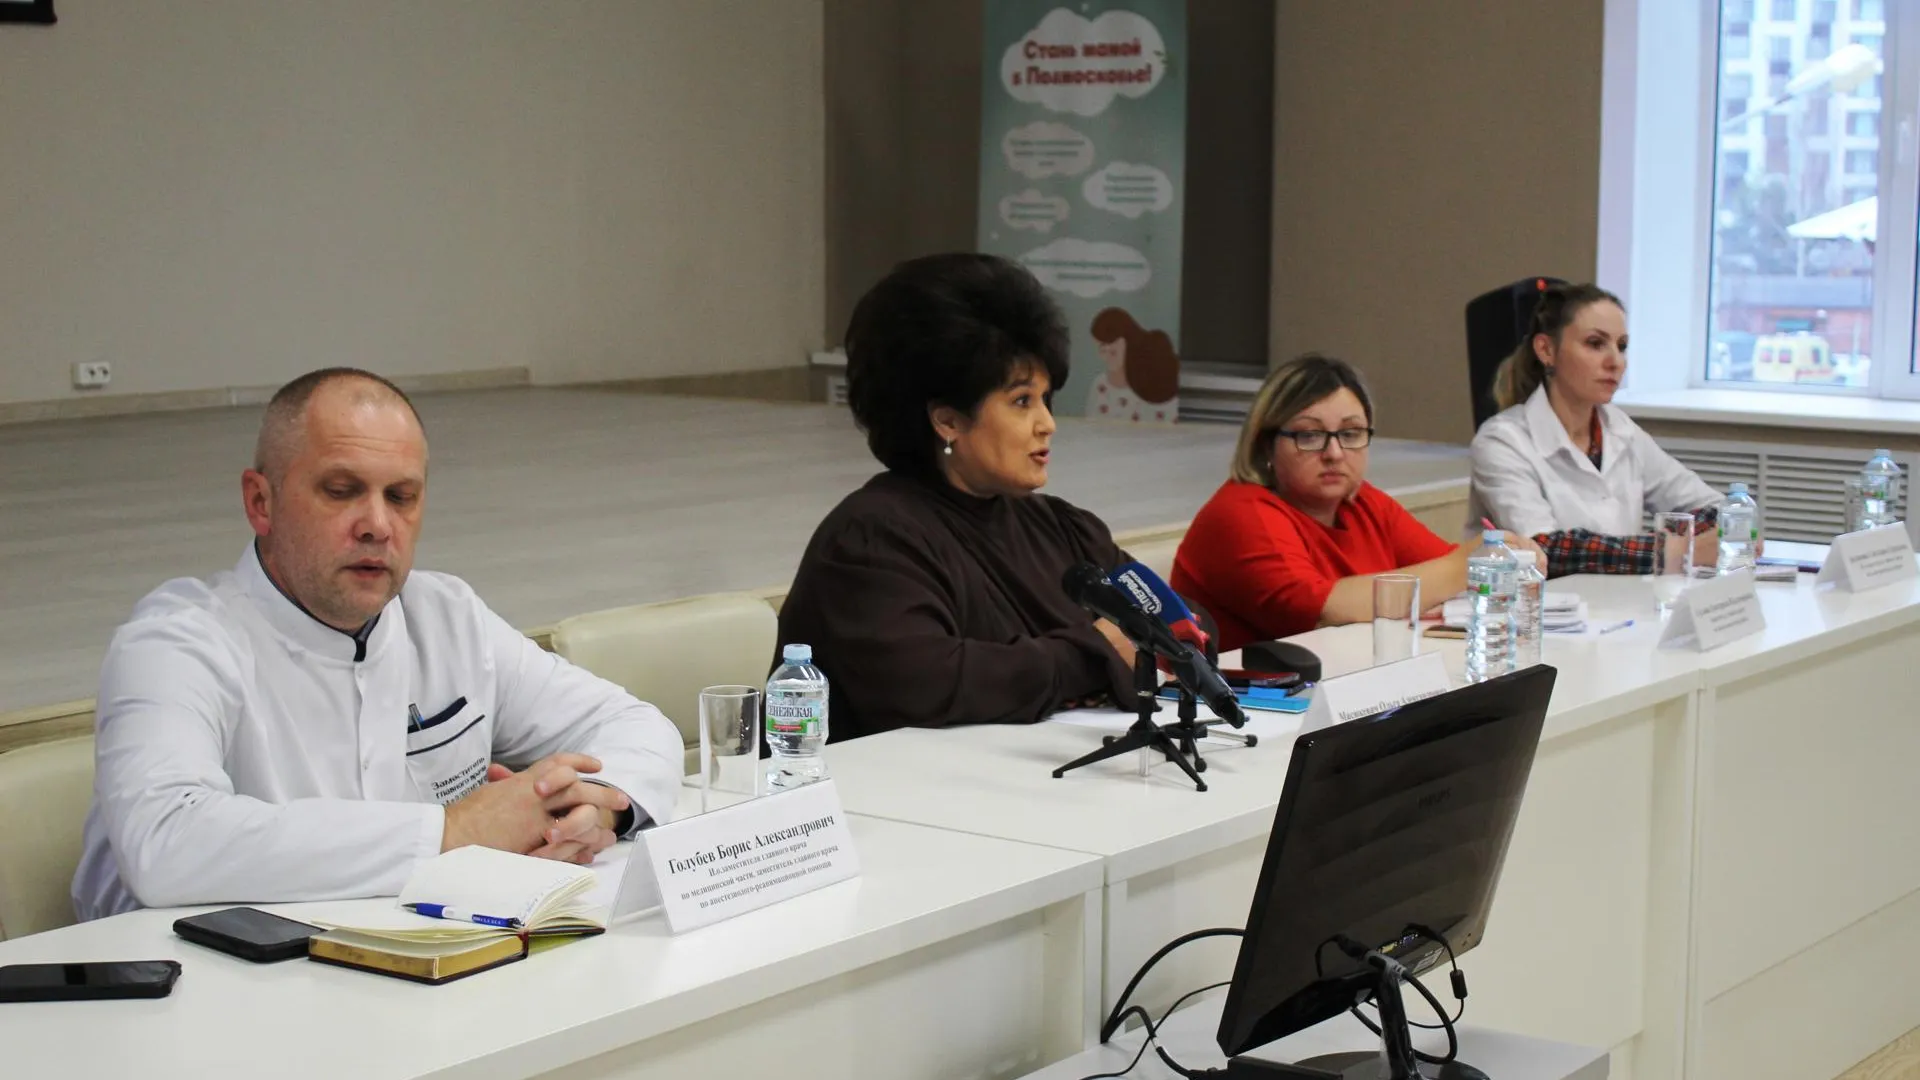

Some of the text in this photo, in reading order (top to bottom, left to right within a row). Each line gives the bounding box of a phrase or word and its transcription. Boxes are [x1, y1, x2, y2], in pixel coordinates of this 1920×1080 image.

[1024, 37, 1142, 59] Стань мамой
[1026, 63, 1152, 85] Подмосковье!
[668, 815, 835, 874] Голубев Борис Александрович
[789, 841, 807, 853] врача
[691, 878, 734, 897] медицинской
